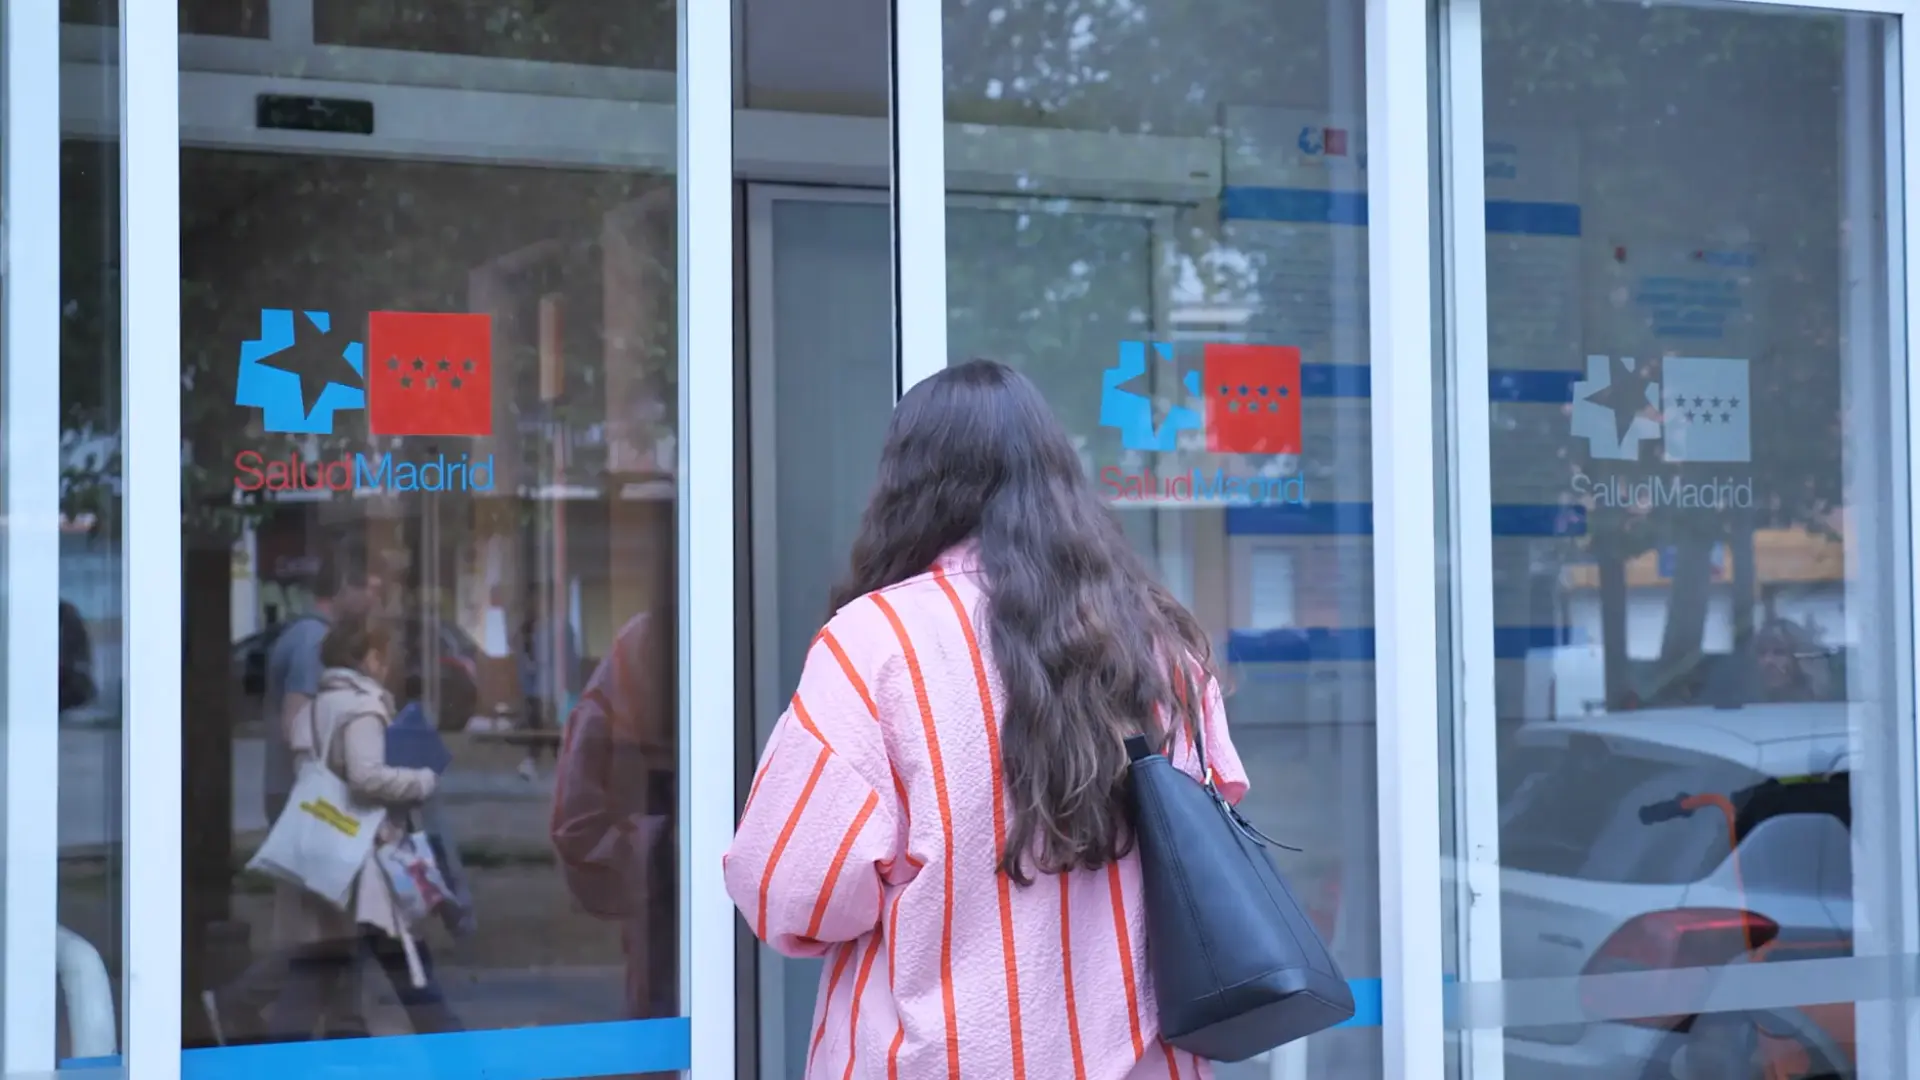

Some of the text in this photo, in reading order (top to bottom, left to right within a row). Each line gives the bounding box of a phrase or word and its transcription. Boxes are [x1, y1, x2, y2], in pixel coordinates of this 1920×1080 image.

[234, 450, 495, 492] SaludMadrid
[1100, 465, 1304, 504] SaludMadrid
[1571, 473, 1753, 508] SaludMadrid
